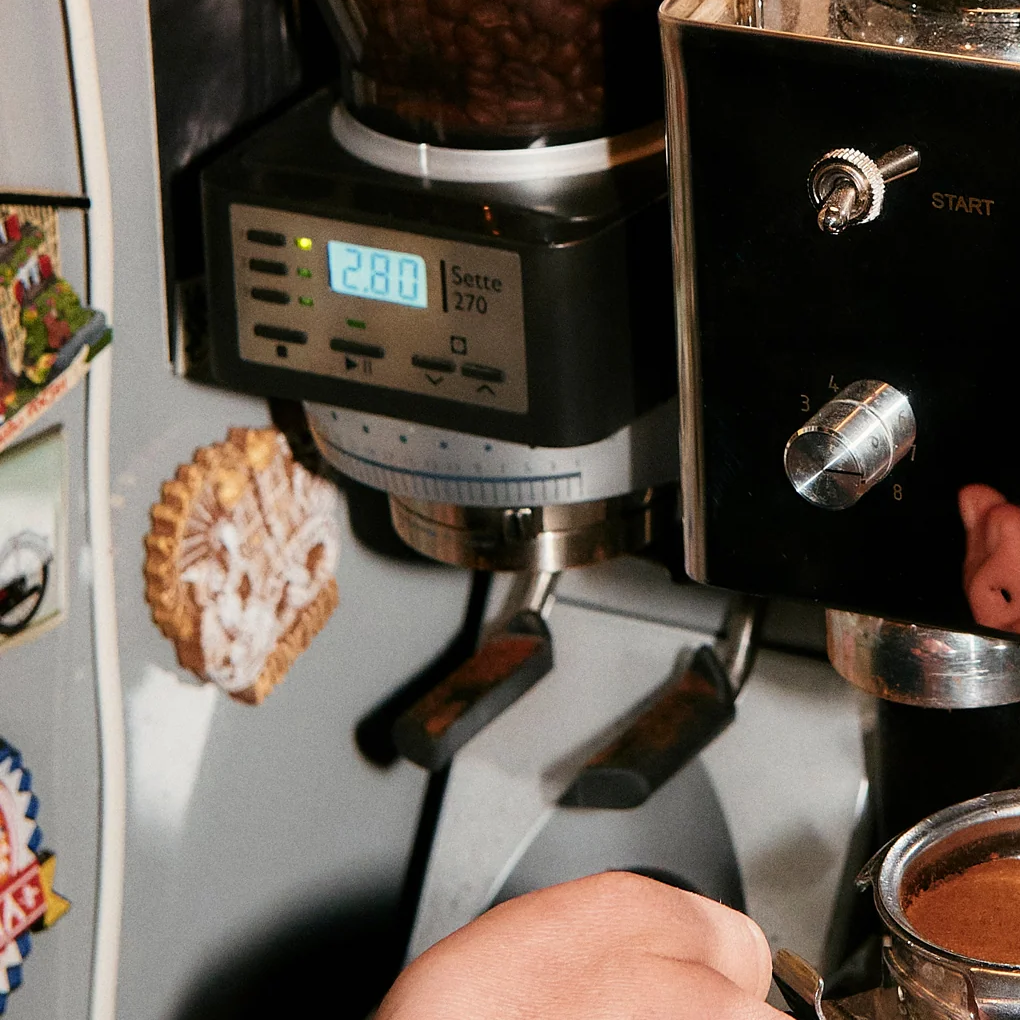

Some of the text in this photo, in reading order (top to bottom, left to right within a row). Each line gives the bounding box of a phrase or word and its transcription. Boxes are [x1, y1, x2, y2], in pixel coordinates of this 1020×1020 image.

[931, 191, 995, 217] START
[341, 247, 419, 302] 2.80
[451, 266, 502, 293] Sette
[453, 292, 489, 315] 270
[800, 394, 810, 412] 3
[893, 483, 902, 501] 8
